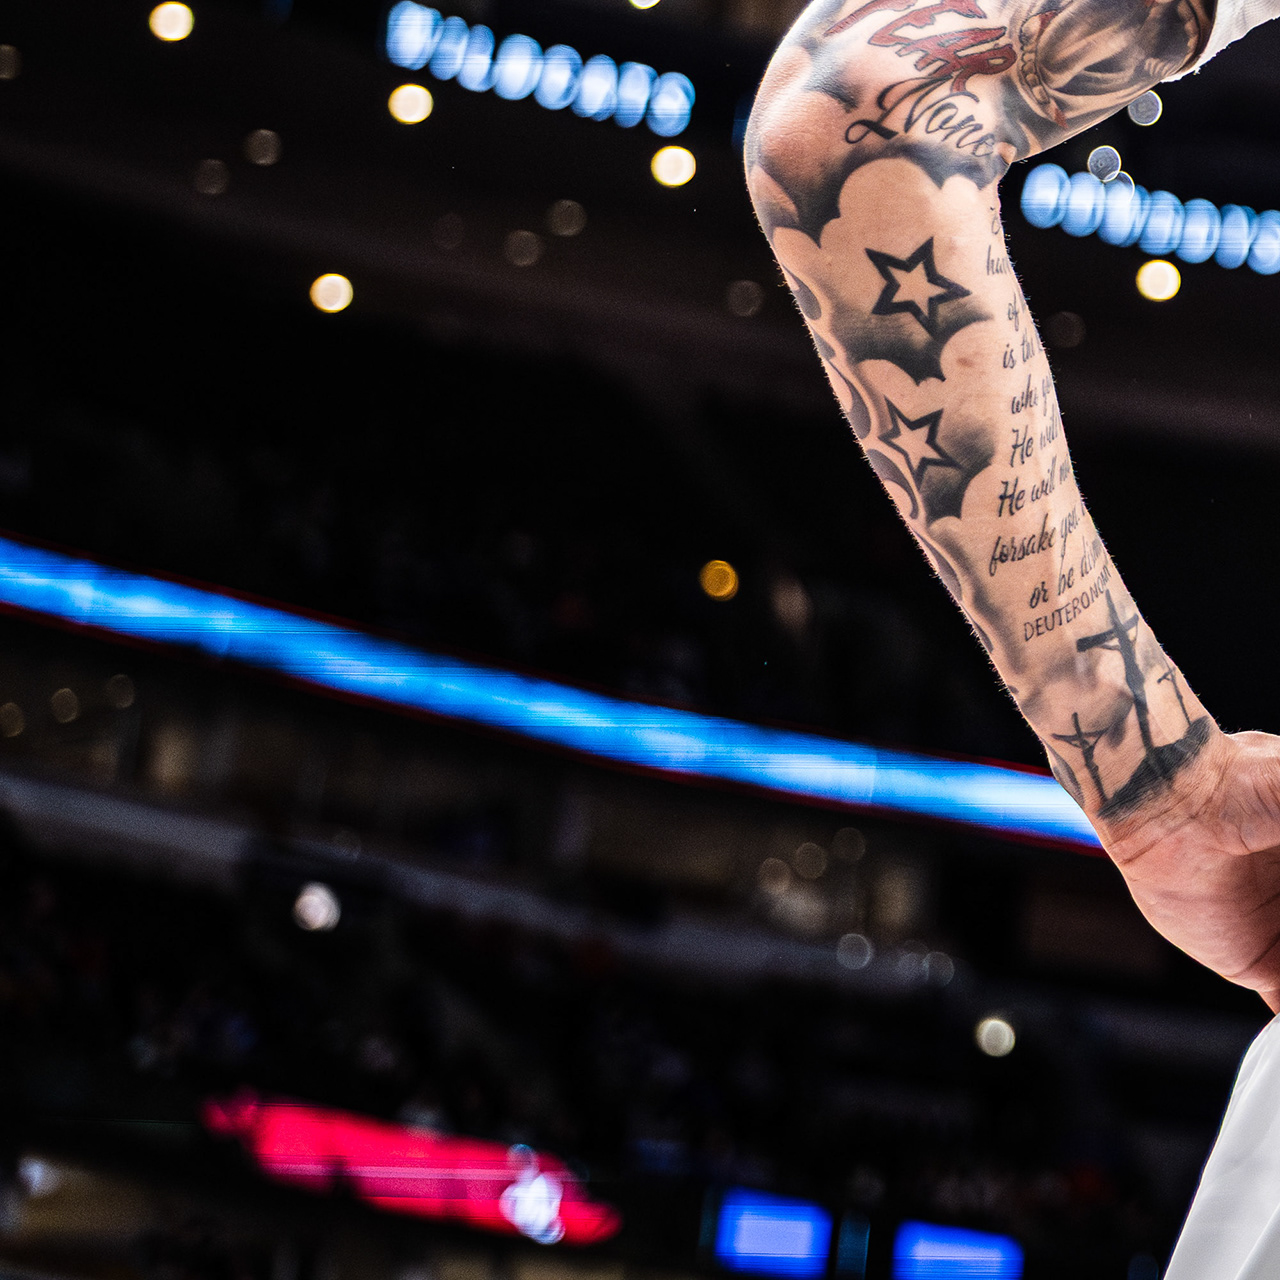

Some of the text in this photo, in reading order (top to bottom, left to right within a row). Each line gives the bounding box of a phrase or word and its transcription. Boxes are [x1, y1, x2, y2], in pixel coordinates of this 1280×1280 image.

[1002, 343, 1016, 370] is
[1010, 424, 1034, 468] He
[998, 476, 1026, 518] He
[989, 512, 1057, 577] forsake
[1029, 580, 1049, 610] or
